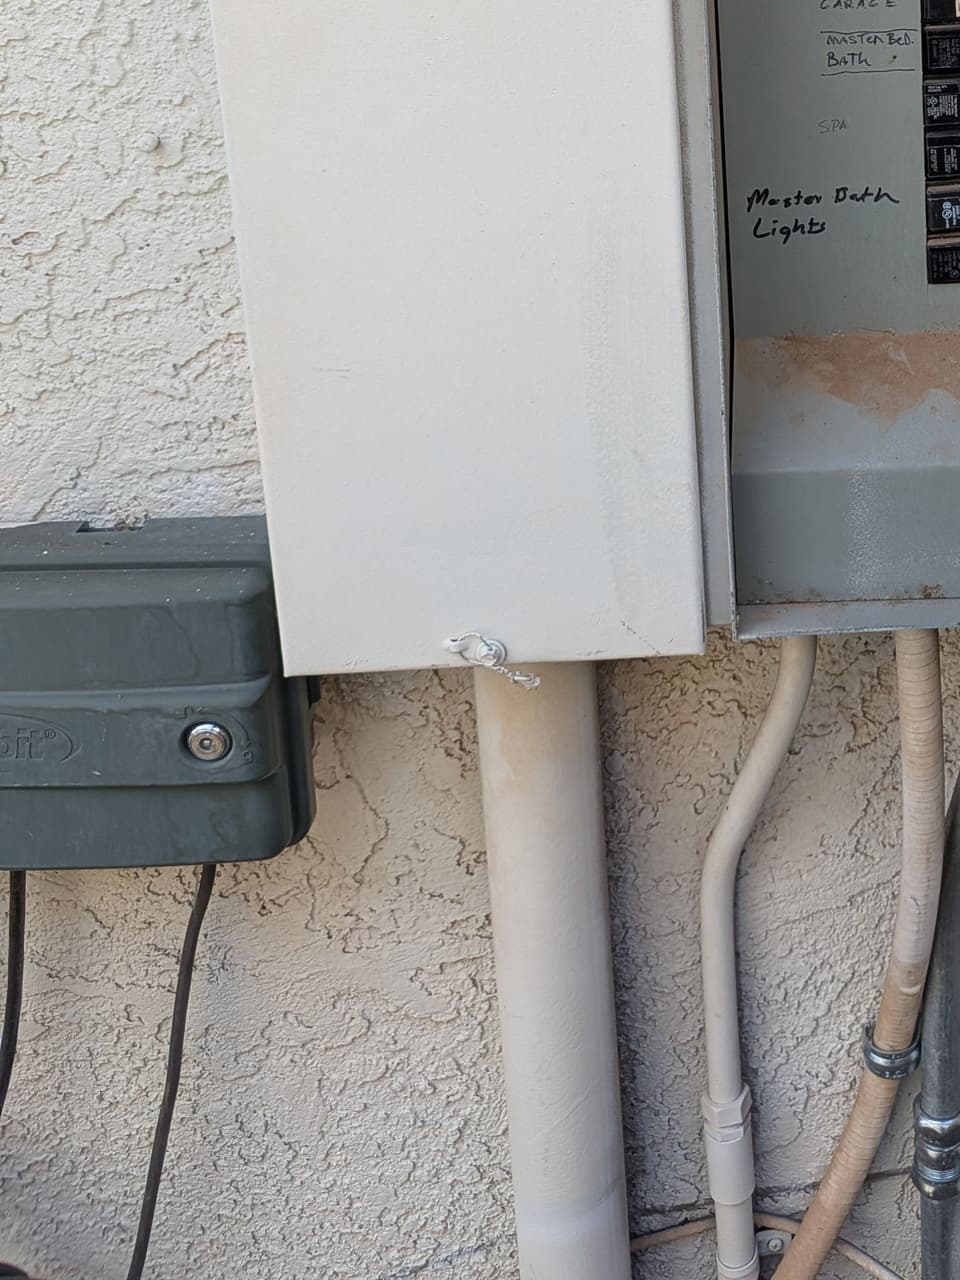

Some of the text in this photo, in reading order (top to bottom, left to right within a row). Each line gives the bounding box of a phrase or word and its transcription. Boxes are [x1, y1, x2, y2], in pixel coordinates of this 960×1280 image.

[818, 119, 848, 134] SPA
[747, 187, 900, 212] Master Bath
[753, 218, 826, 244] Lights
